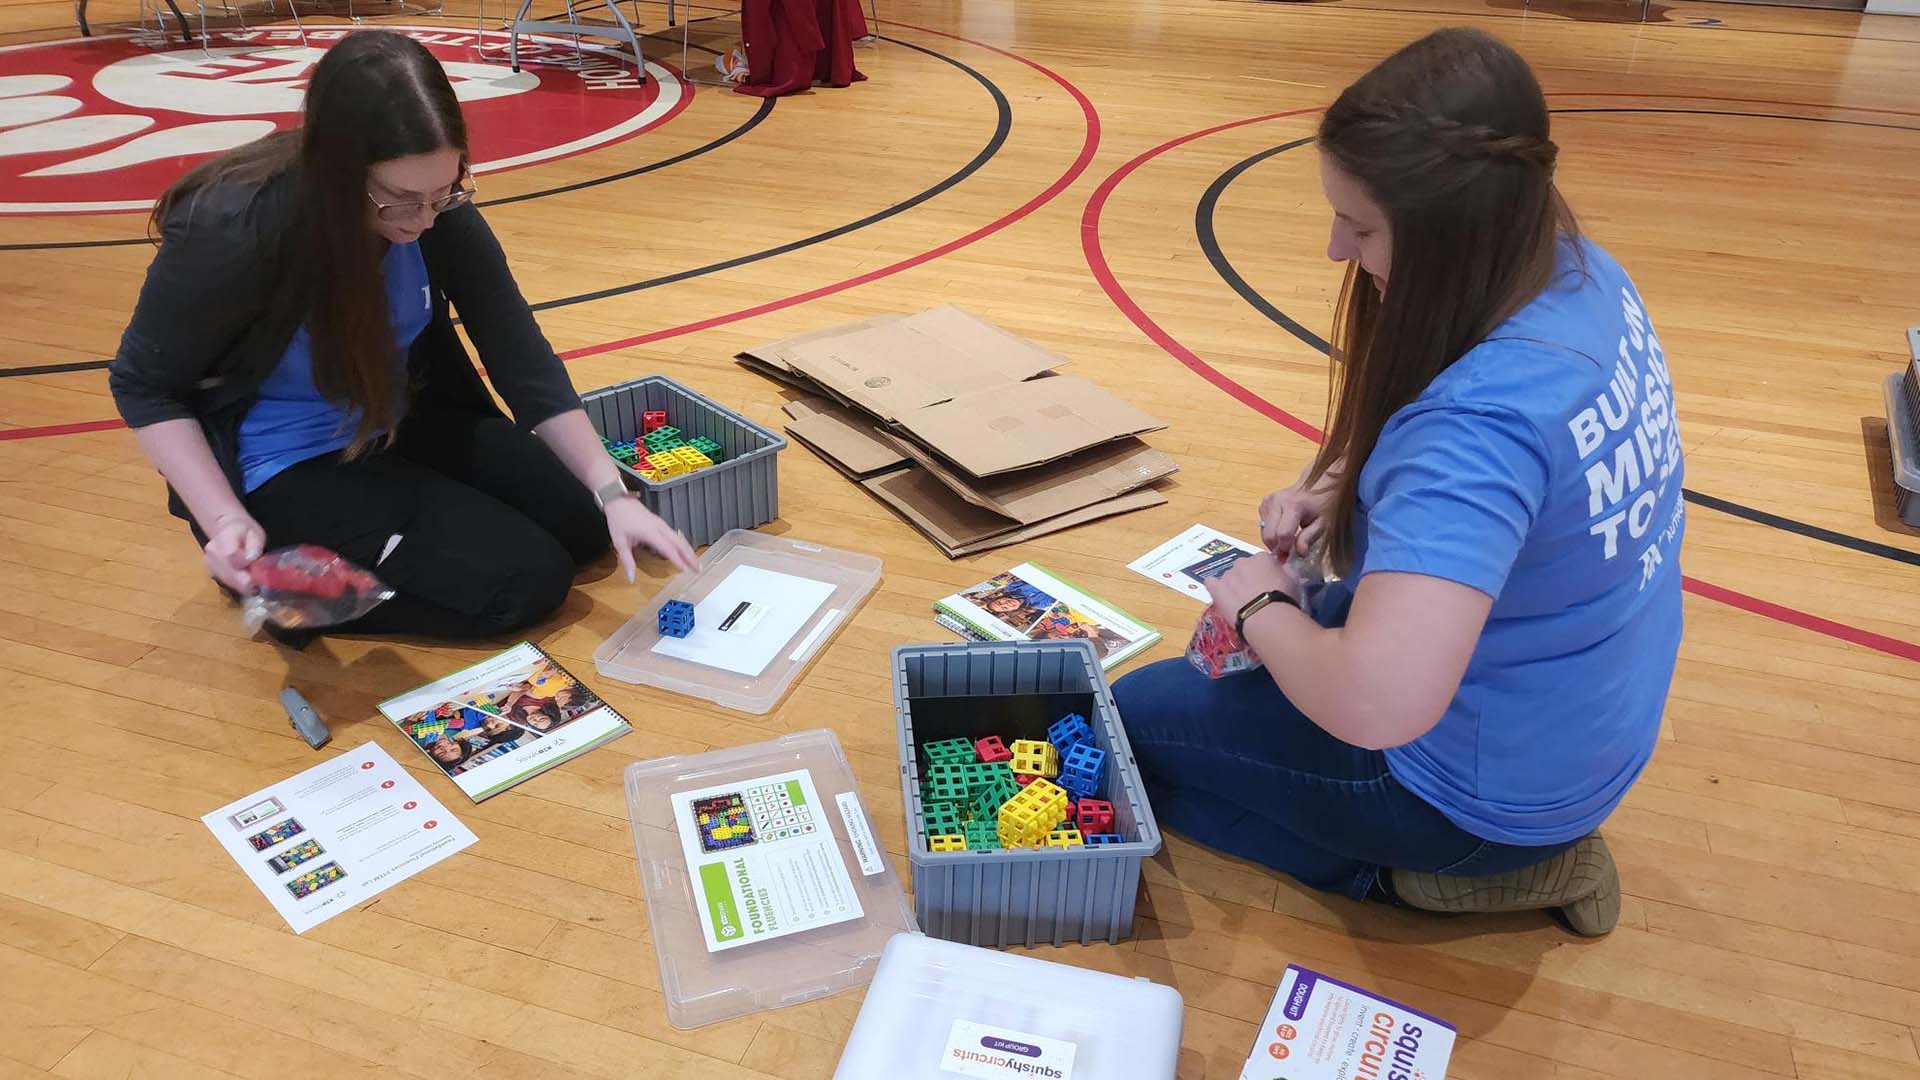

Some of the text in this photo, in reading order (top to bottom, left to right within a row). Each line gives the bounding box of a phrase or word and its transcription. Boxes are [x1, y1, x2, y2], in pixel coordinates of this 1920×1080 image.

[1568, 287, 1645, 460] BUILT ON
[1585, 333, 1670, 517] MISSIO
[1590, 490, 1656, 560] TO
[733, 857, 765, 935] FOUNDATIONAL
[1289, 983, 1308, 1017] DOUGH KIT
[994, 1040, 1029, 1053] GROUP KIT
[1346, 1031, 1360, 1056] create
